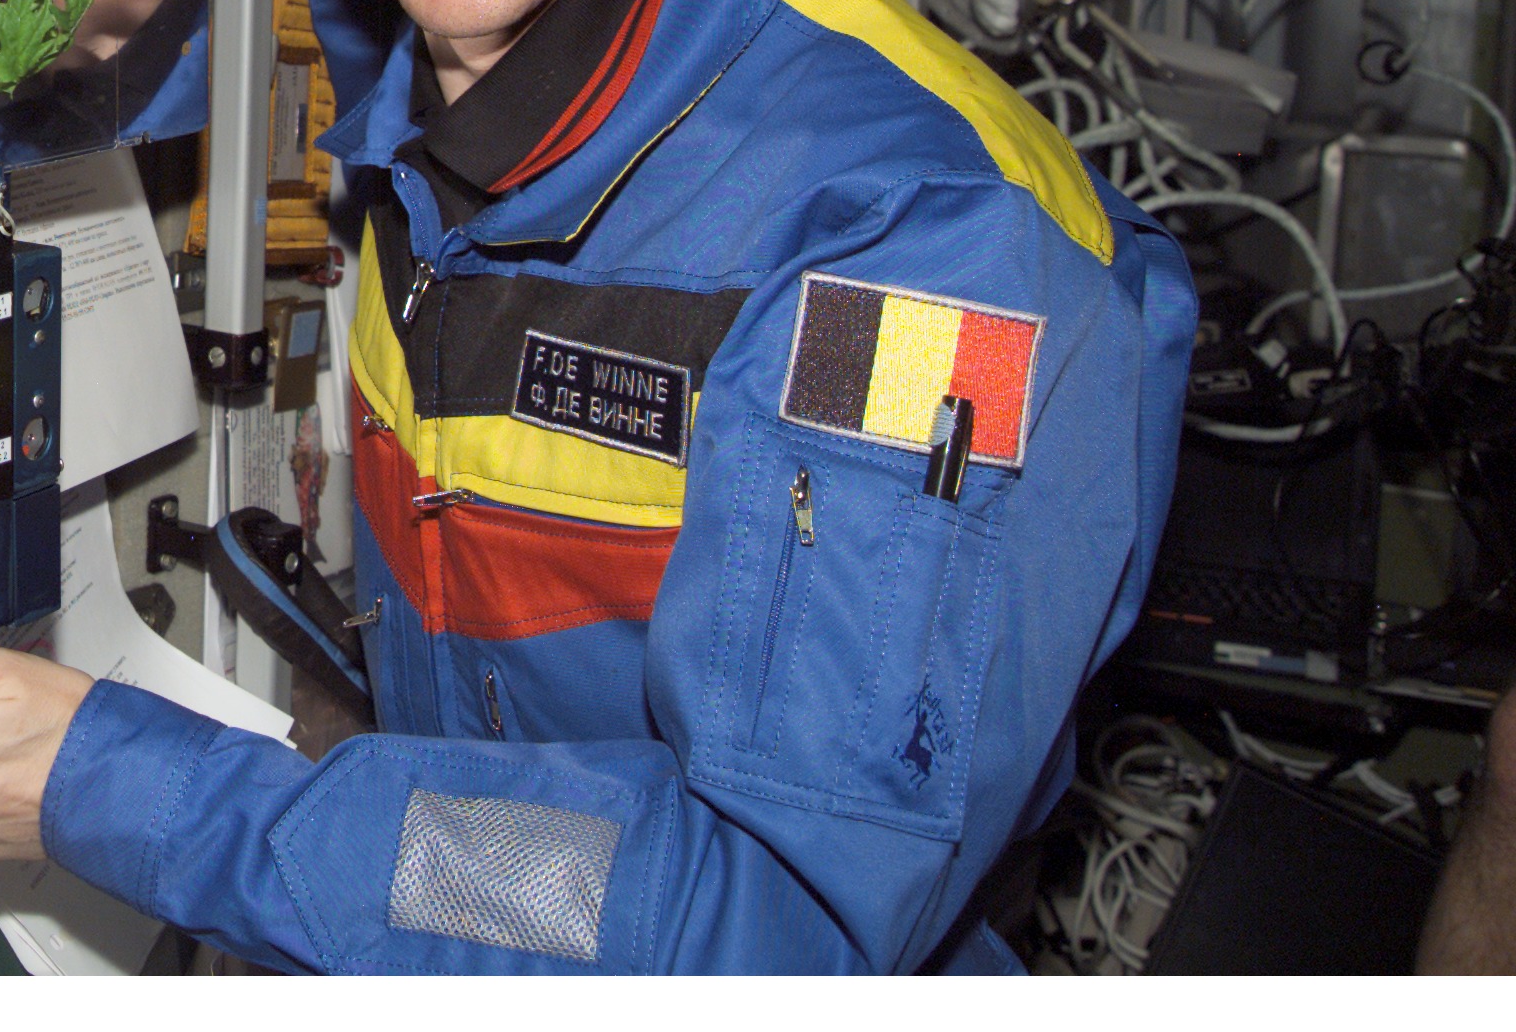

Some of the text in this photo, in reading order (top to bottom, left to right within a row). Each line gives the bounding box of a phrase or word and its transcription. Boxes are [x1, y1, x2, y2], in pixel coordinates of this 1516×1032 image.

[593, 359, 668, 404] WINNE
[530, 381, 664, 440] Ф. ДЕ ВИННЕ
